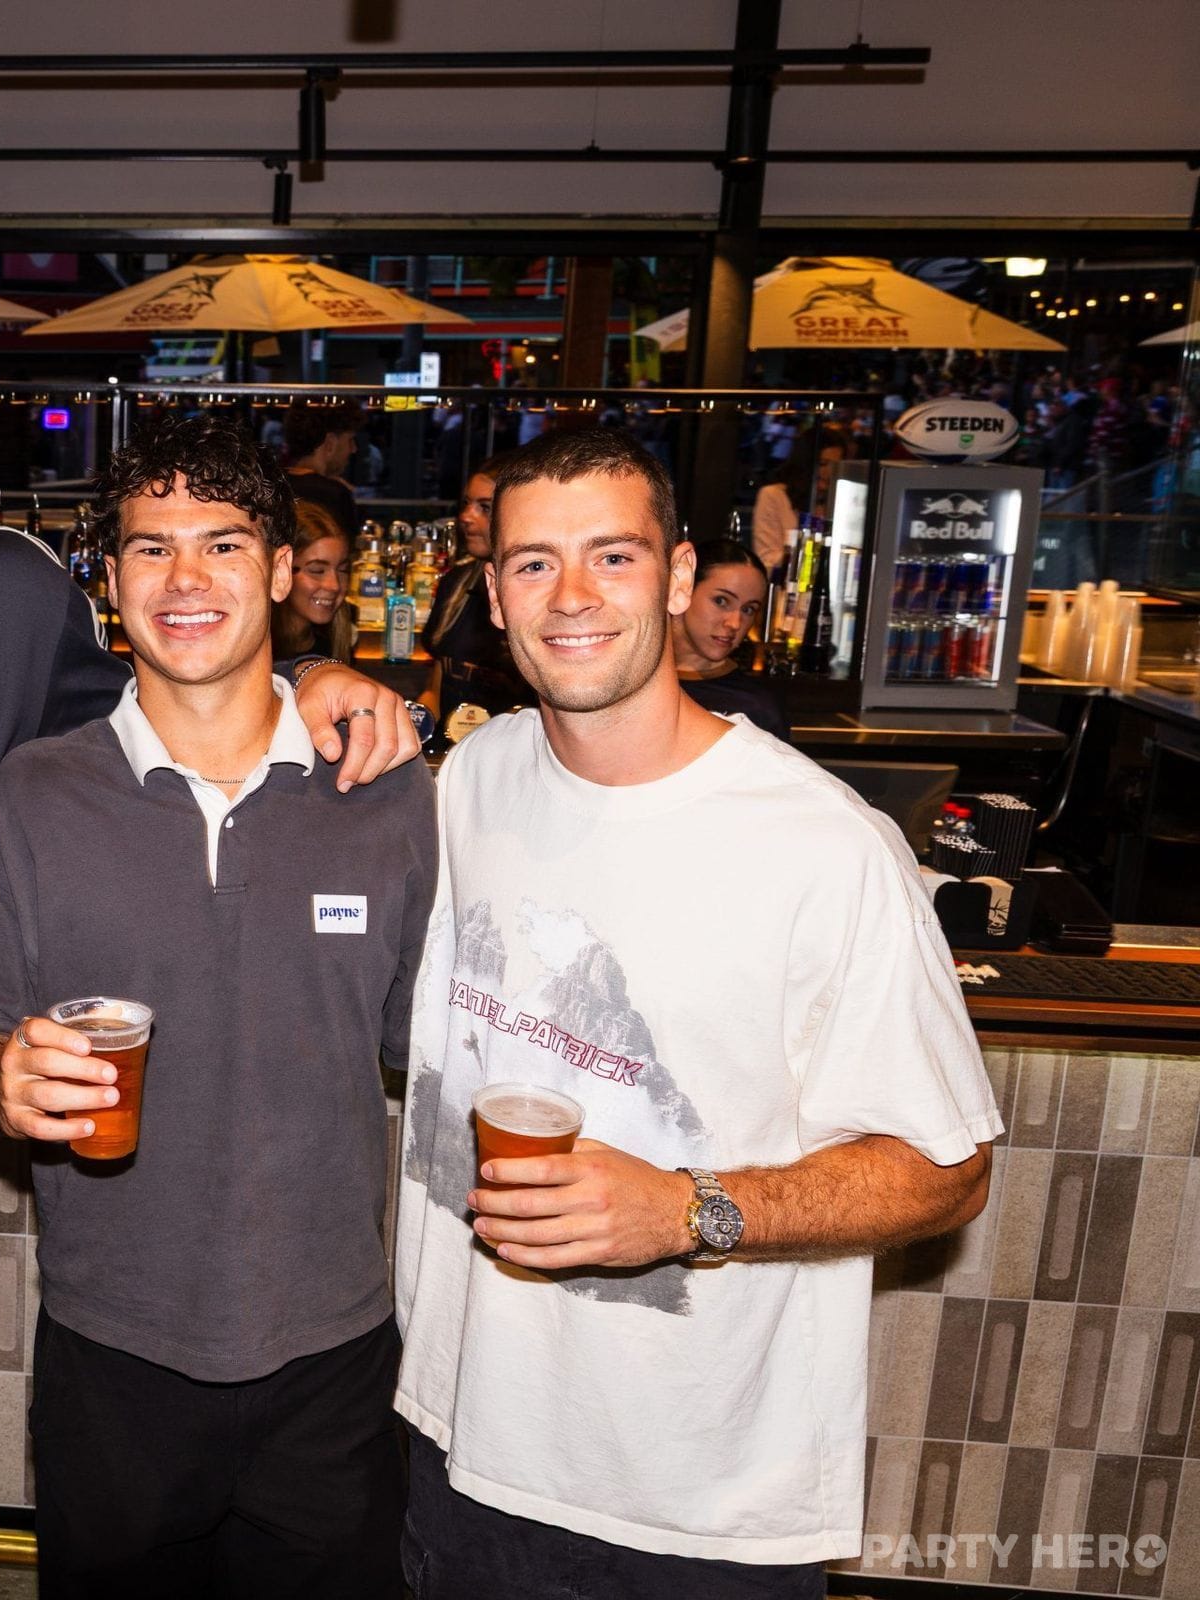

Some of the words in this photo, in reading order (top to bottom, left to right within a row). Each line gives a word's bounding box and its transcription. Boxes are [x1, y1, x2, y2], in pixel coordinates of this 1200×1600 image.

[131, 302, 210, 315] GREAT
[794, 316, 903, 328] GREAT
[796, 329, 909, 337] NORTHERN
[925, 416, 1004, 433] STEEDEN
[909, 520, 953, 539] Red
[954, 520, 995, 540] Bull
[319, 907, 360, 920] payne
